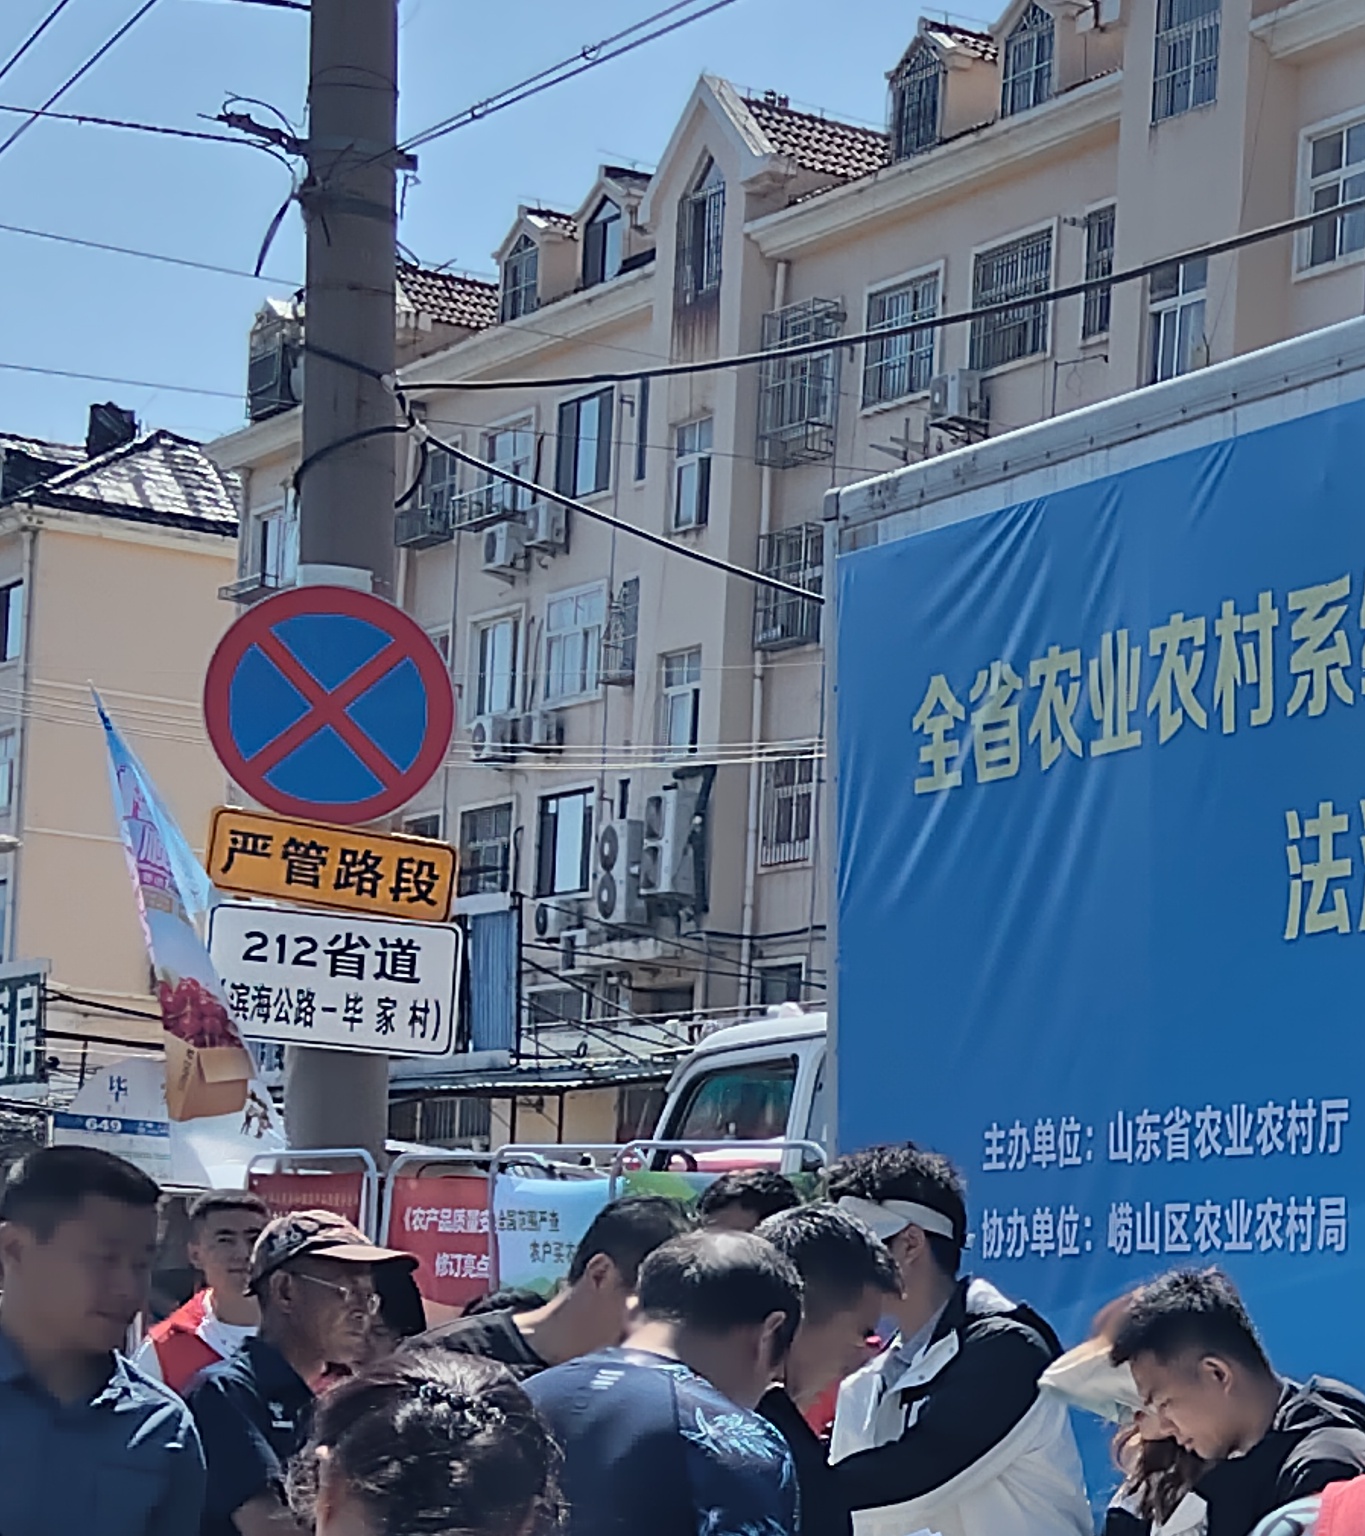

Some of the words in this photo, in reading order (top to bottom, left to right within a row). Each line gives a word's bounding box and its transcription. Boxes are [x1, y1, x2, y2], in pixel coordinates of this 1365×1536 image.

[221, 829, 440, 907] 严管路段
[242, 930, 421, 984] 212省道
[85, 1116, 122, 1133] 649
[981, 1097, 1350, 1174] 主办单位：山东省农业农村厅
[980, 1195, 1349, 1262] 协办单位：崂山区农业农村局
